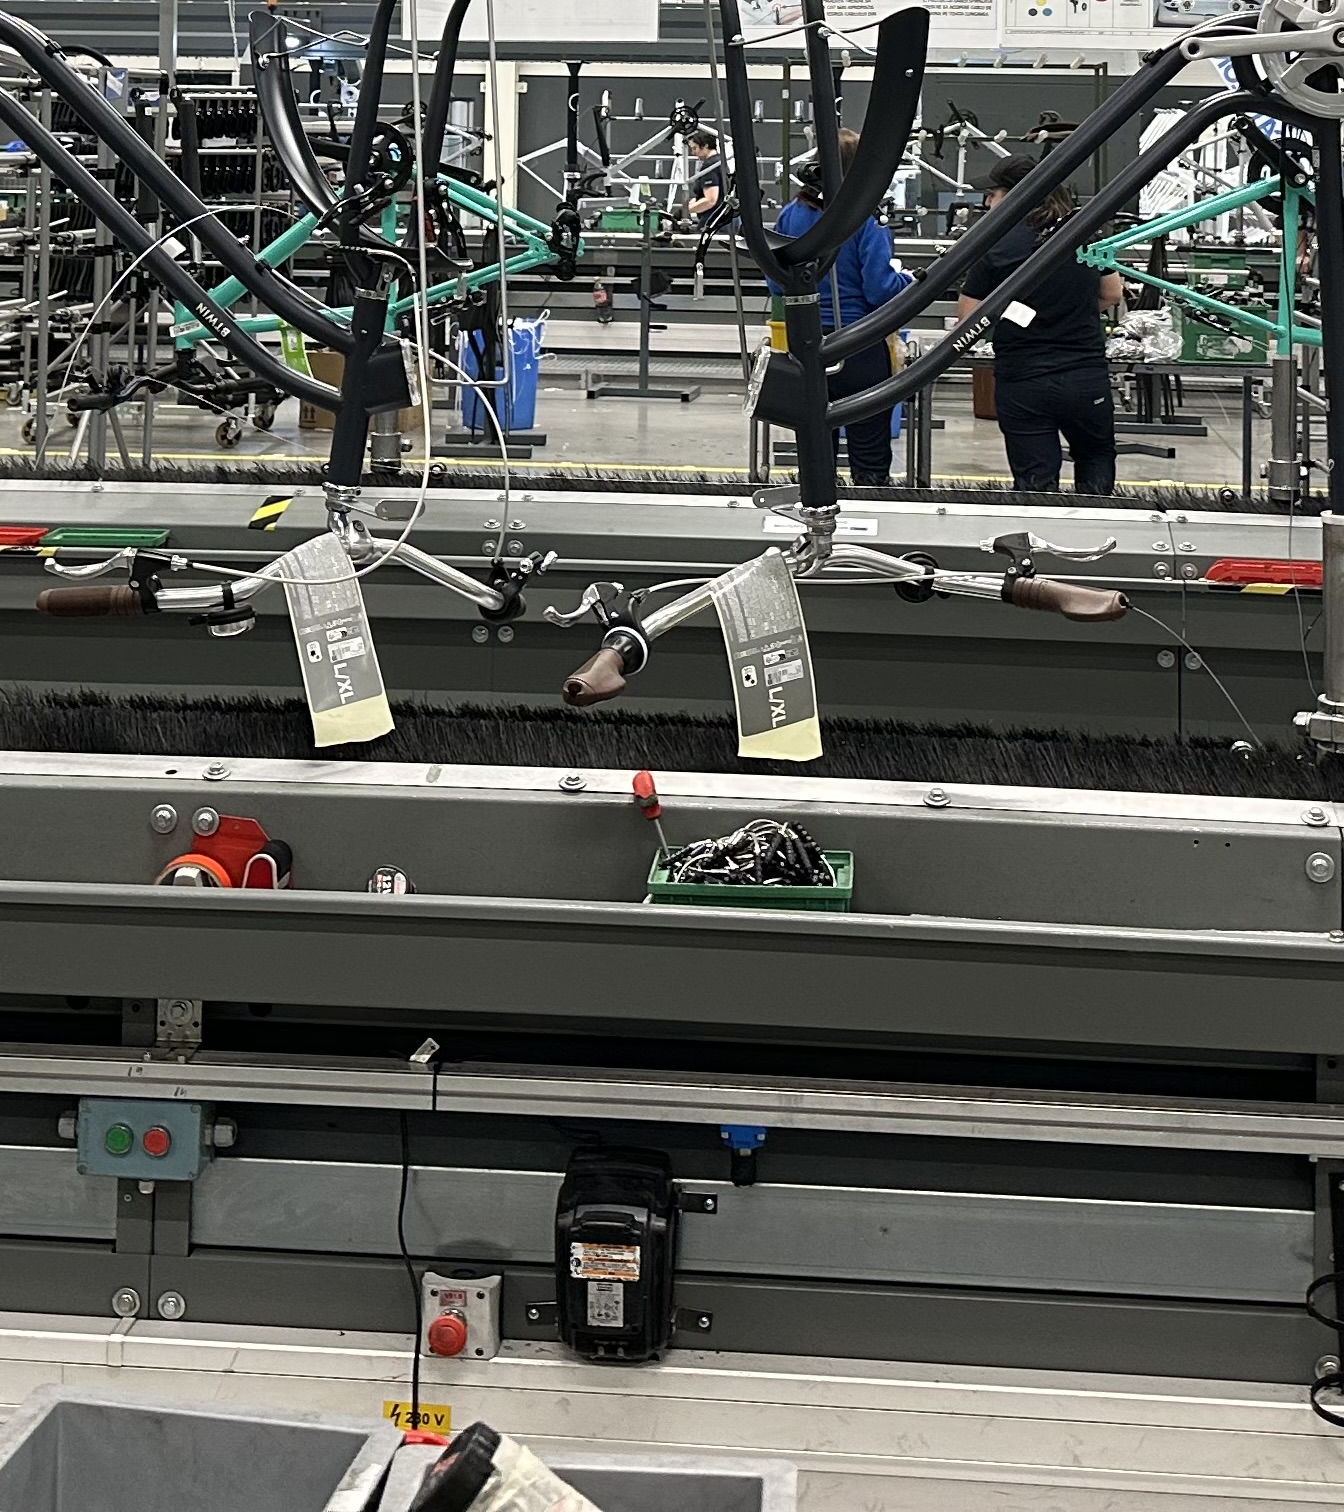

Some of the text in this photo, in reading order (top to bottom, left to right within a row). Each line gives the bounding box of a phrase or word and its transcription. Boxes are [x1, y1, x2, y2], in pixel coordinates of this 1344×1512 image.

[195, 302, 231, 338] BTWIN
[952, 316, 991, 352] BTWIN
[333, 662, 355, 705] L/XL
[768, 686, 787, 728] L/XL
[434, 1413, 445, 1426] V
